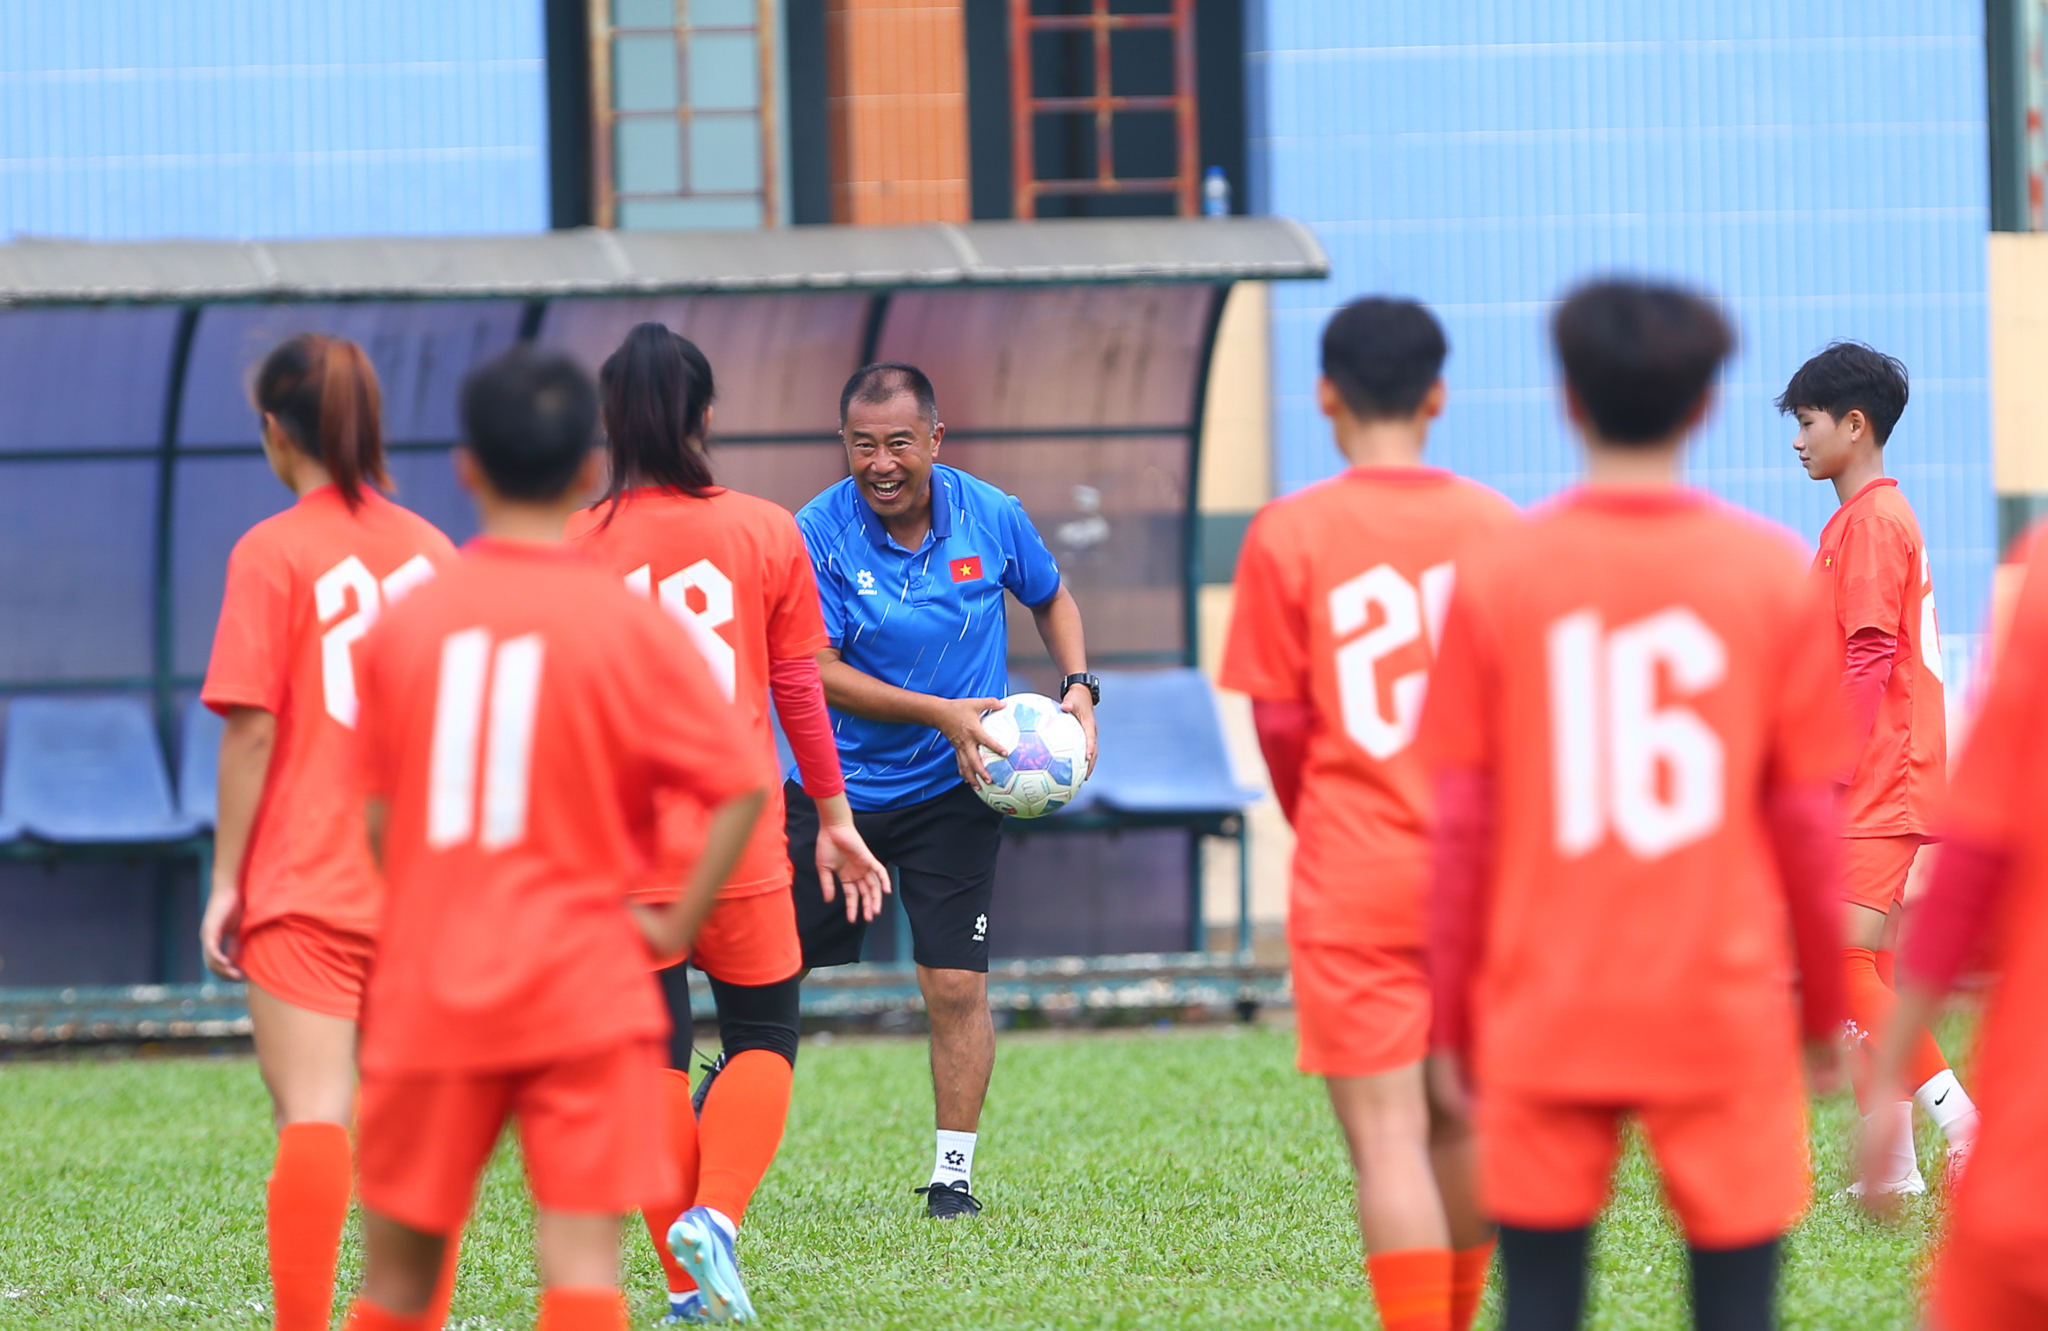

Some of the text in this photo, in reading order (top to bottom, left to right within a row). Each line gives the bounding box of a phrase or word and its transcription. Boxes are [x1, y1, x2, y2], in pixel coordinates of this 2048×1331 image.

[315, 554, 437, 731] 2
[426, 626, 546, 851] 11
[1546, 605, 1728, 862] 16
